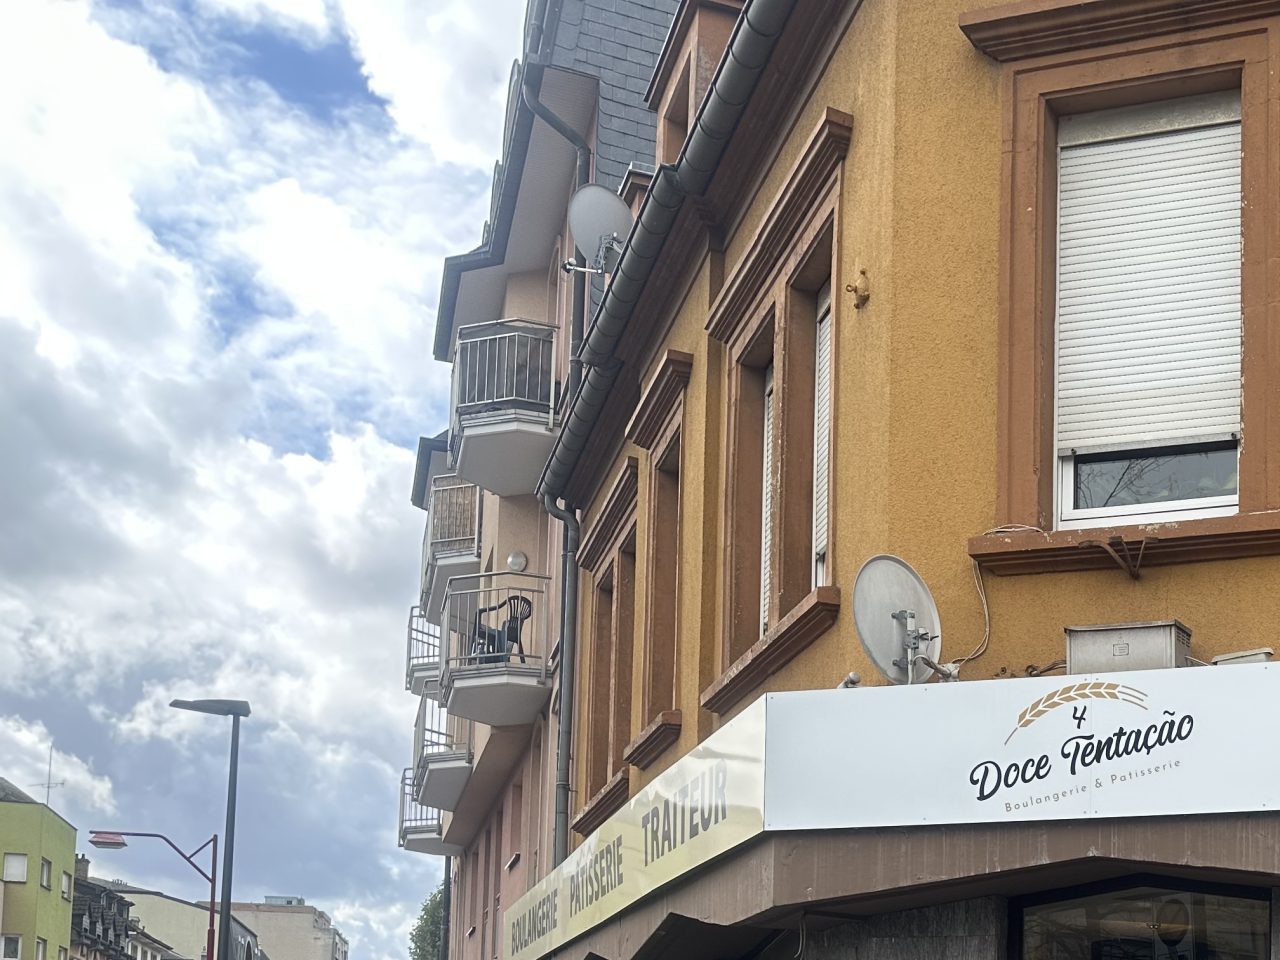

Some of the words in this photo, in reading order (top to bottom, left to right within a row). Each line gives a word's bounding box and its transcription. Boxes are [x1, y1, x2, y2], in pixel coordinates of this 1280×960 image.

[969, 754, 1051, 801] Doce
[1060, 710, 1194, 775] Tentação
[1005, 785, 1088, 812] Boulangerie
[1094, 778, 1103, 788] &
[1110, 759, 1181, 784] Patisserie
[512, 888, 558, 956] BOULANGERIE
[569, 834, 624, 917] PÂTISSERIE
[641, 759, 727, 867] TRAITEUR
